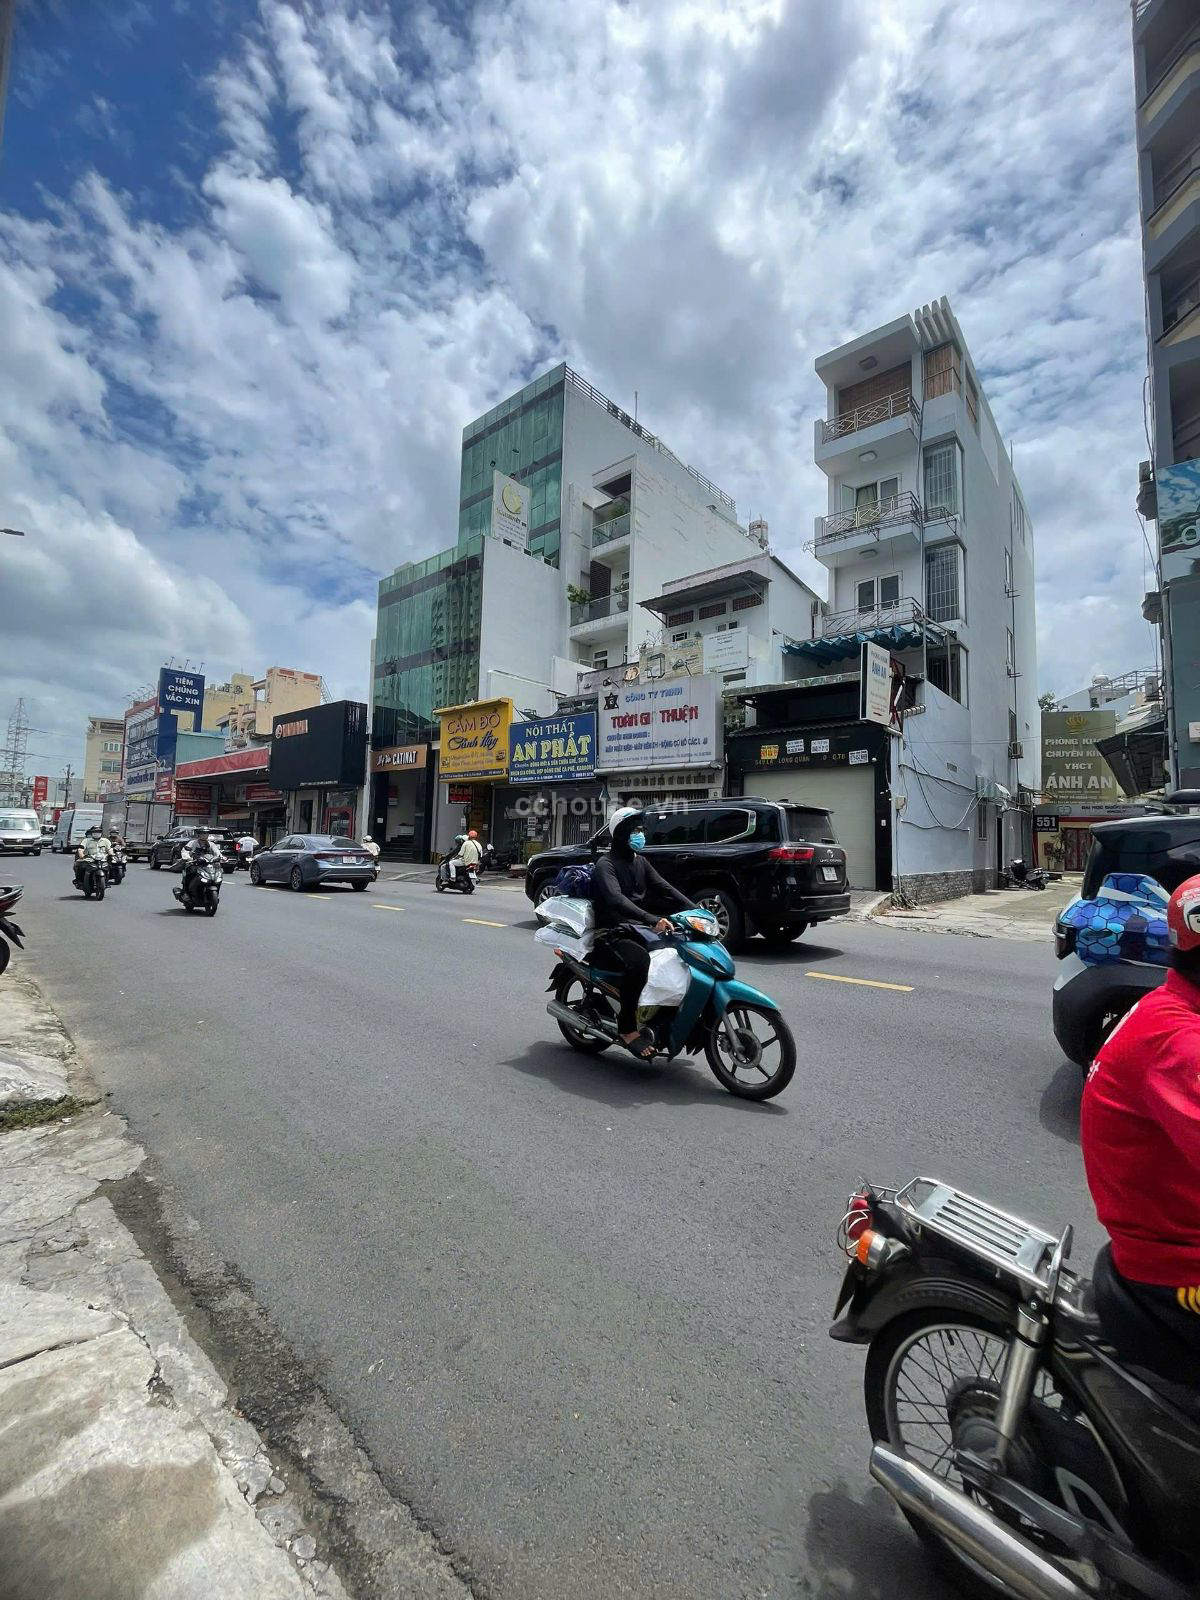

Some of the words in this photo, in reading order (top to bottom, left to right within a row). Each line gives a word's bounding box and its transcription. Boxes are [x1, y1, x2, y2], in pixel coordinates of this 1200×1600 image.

[174, 676, 194, 686] TIÊM
[168, 684, 199, 696] CHỦNG
[625, 692, 646, 703] CÔNG
[648, 691, 658, 700] TY
[660, 687, 683, 699] TNHH
[165, 692, 183, 703] VẮC
[185, 697, 200, 706] XIN
[611, 711, 638, 729] TOÀN
[525, 724, 543, 739] NỘI
[545, 718, 575, 734] THẤT
[512, 741, 538, 762] AN
[541, 732, 591, 760] PHÁT
[1046, 772, 1082, 789] ÁNH
[1087, 776, 1113, 789] AN
[1036, 816, 1056, 827] 551
